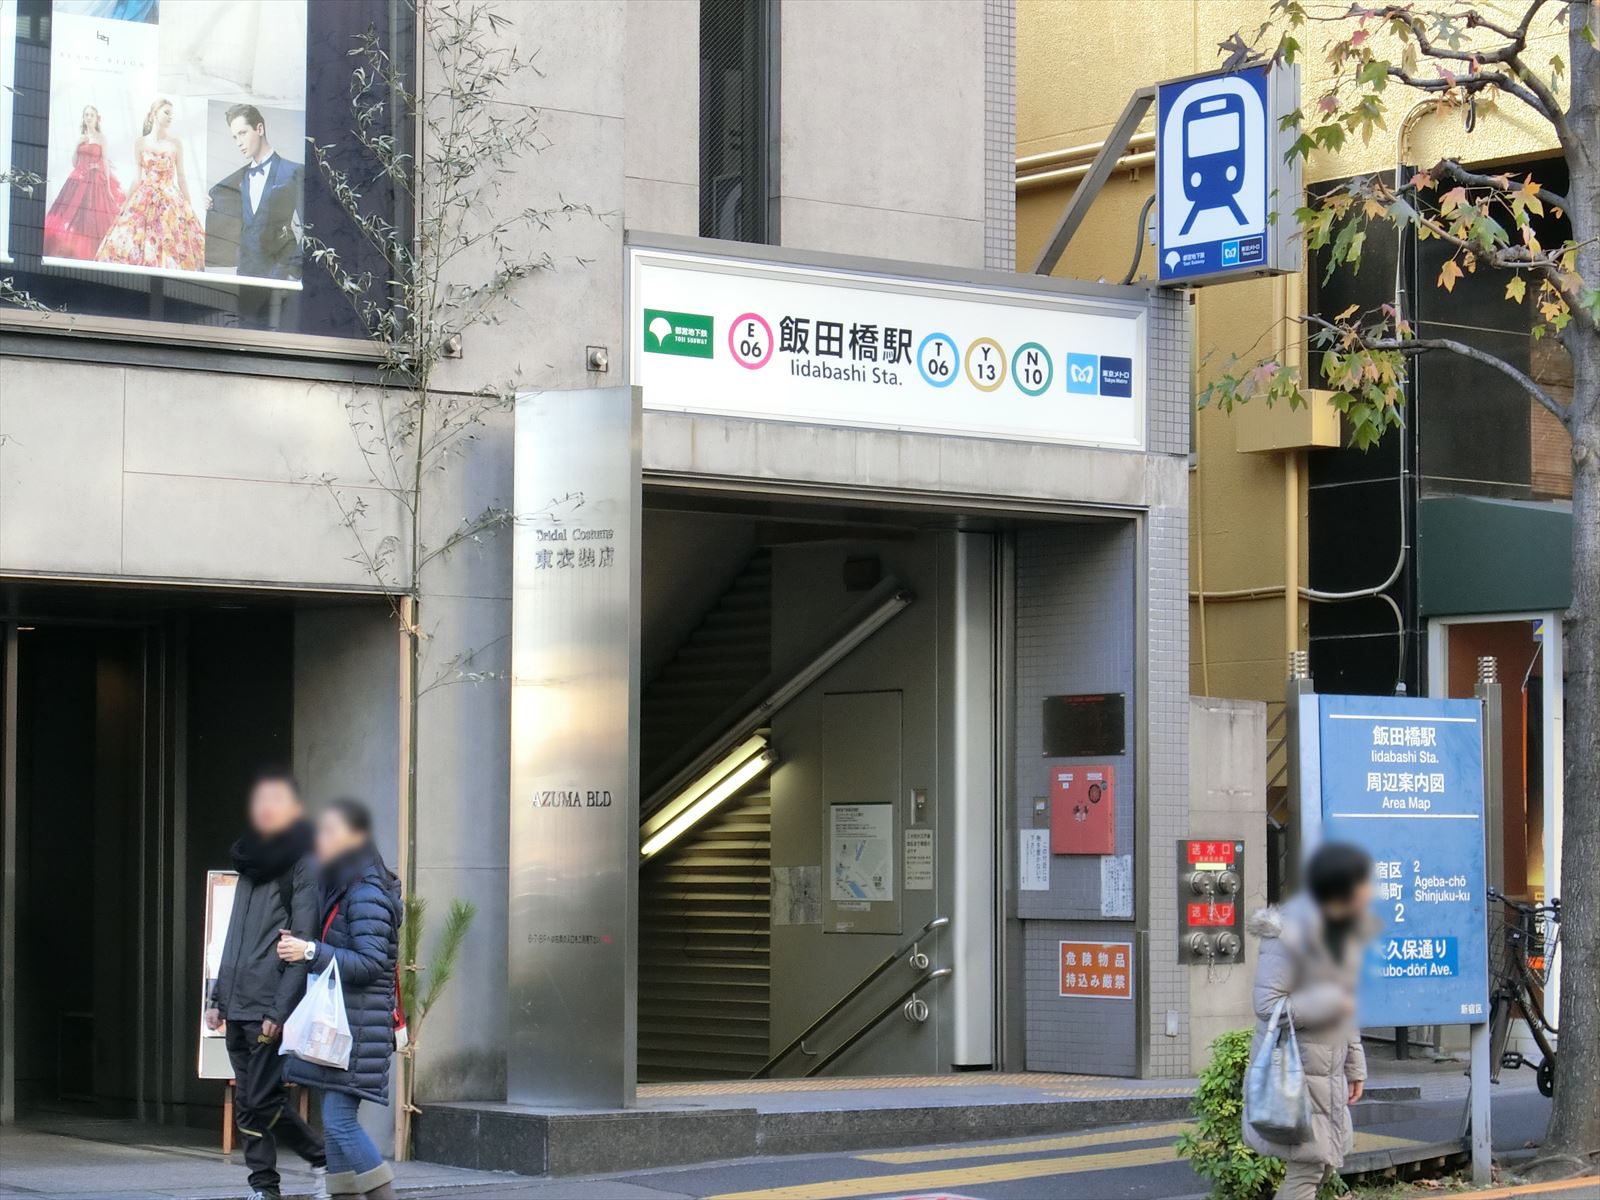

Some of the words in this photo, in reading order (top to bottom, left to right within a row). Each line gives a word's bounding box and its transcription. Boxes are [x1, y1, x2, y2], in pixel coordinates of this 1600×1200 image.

[747, 323, 754, 338] E
[687, 337, 708, 345] SUBWAY
[779, 315, 912, 365] 飯田橋駅
[740, 340, 762, 358] 06
[934, 342, 943, 356] T
[981, 347, 991, 361] Y
[1026, 351, 1038, 366] N
[791, 359, 866, 383] Iidabashi
[872, 367, 903, 386] Sta.
[928, 359, 949, 376] 06
[977, 364, 996, 381] 13
[1024, 368, 1043, 385] 10
[572, 528, 614, 541] Costume
[1372, 725, 1437, 747] 飯田橋駅
[1371, 750, 1417, 763] Iidabashi
[1419, 750, 1439, 764] Sta.
[1366, 772, 1445, 793] 周辺案内図
[533, 791, 582, 807] AZUMA
[587, 791, 612, 807] BLD
[1382, 796, 1406, 809] Area
[1408, 796, 1431, 811] Map
[1192, 843, 1230, 855] 送水口
[1375, 861, 1402, 879] 宿区
[1413, 860, 1420, 872] 2
[1415, 889, 1470, 904] Shinjuku-ku
[1394, 903, 1405, 922] 2
[1065, 951, 1126, 968] 危険物品
[1429, 962, 1452, 976] Ave.
[1065, 974, 1126, 989] 持込み厳禁
[1460, 1003, 1483, 1014] 新宿区
